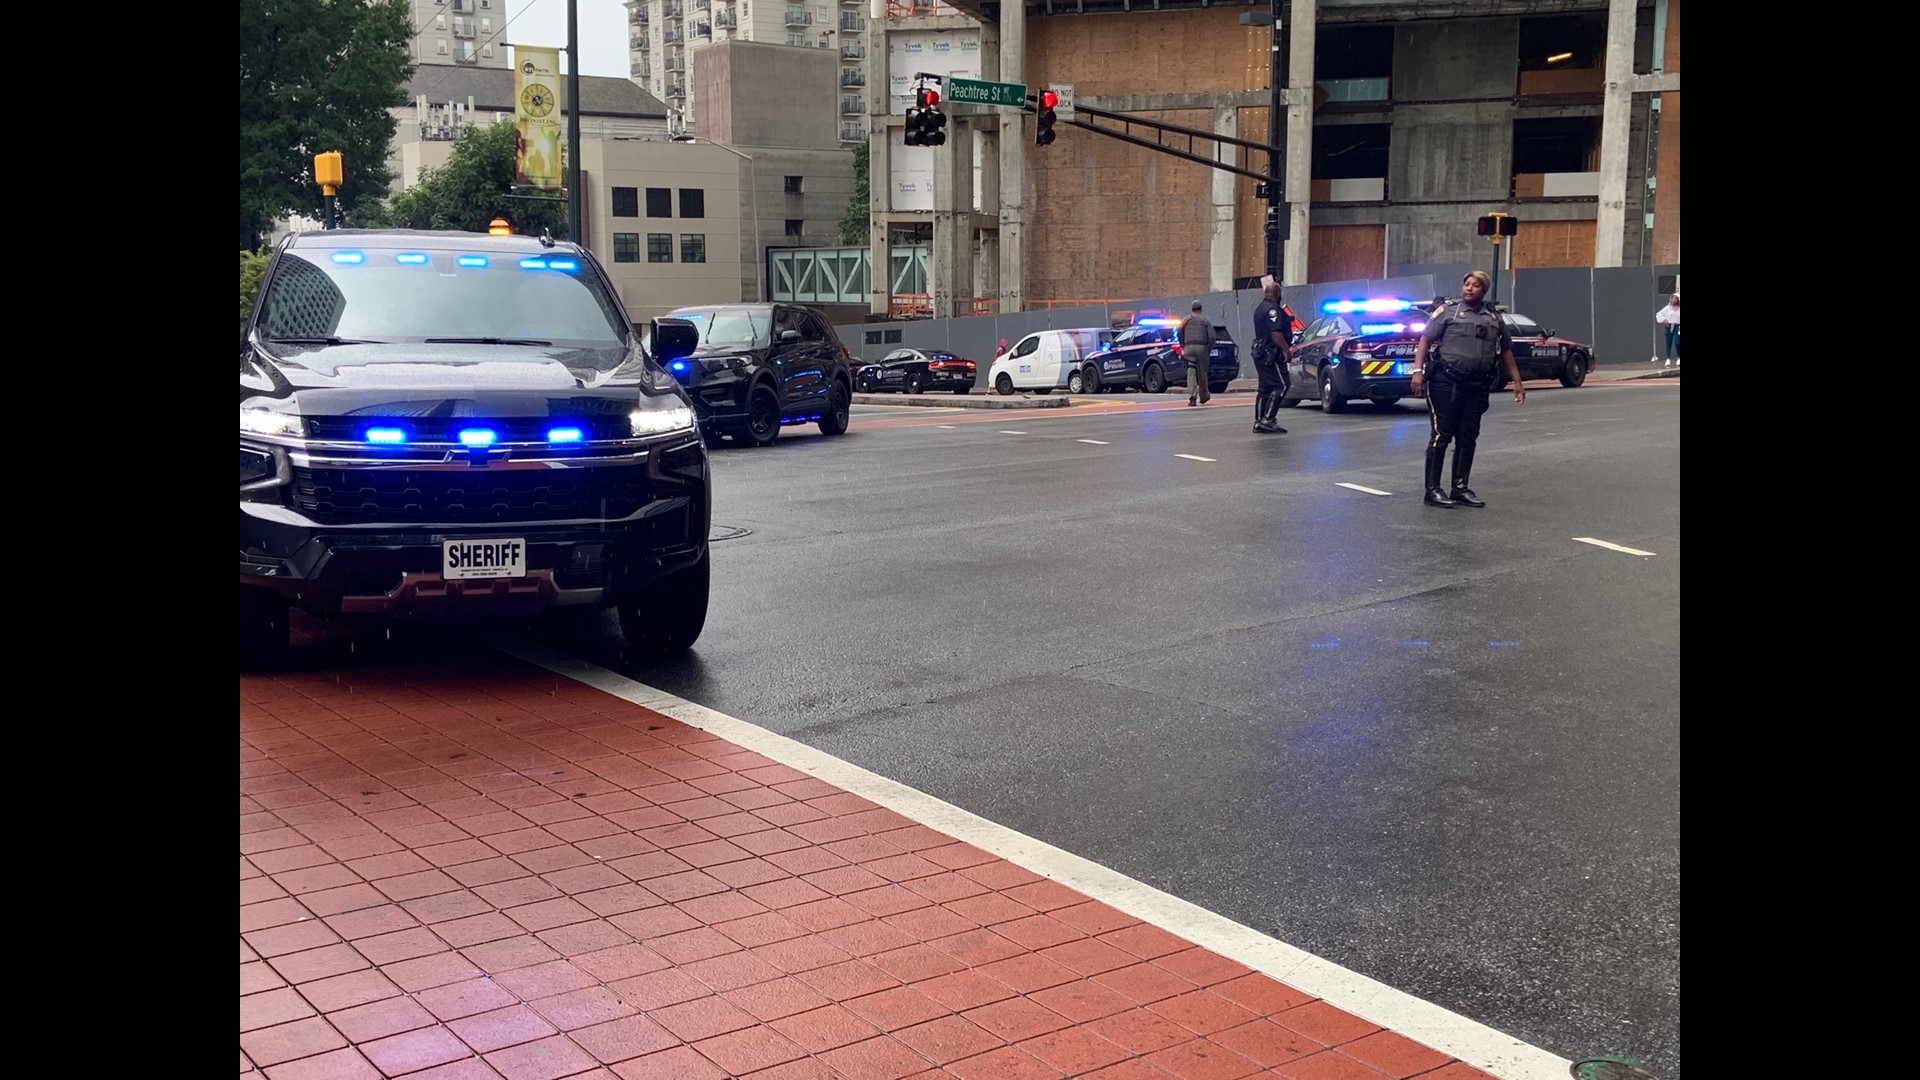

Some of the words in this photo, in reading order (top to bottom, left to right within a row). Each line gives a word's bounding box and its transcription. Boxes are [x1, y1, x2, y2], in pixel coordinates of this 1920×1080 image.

[950, 82, 988, 99] Peachtree
[991, 87, 1001, 101] St
[448, 543, 521, 568] SHERIFF
